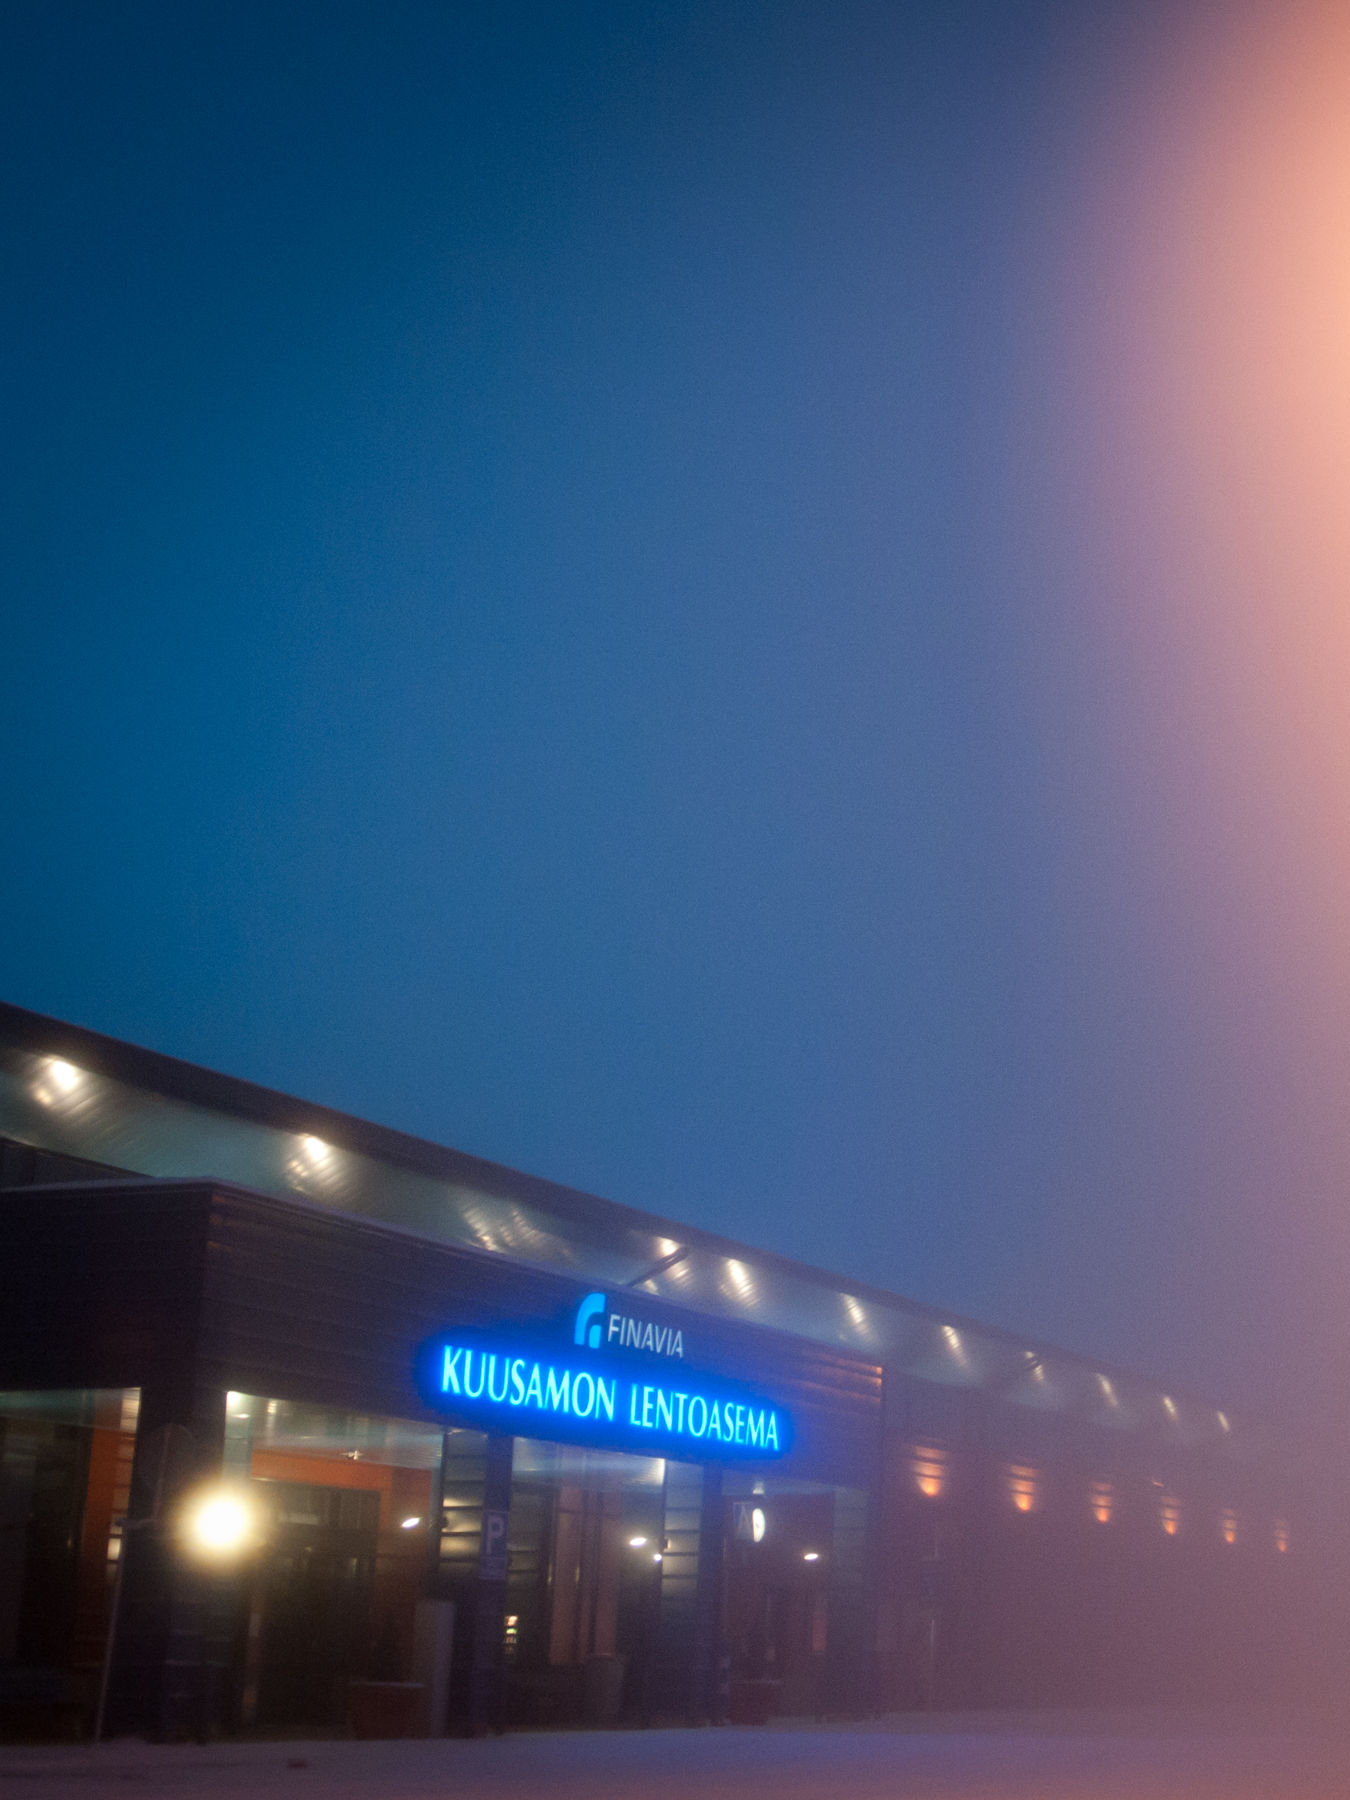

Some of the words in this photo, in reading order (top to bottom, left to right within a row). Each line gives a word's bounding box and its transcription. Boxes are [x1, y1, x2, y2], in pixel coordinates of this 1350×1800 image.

[608, 1314, 683, 1358] FINAVIA
[442, 1345, 616, 1421] KUUSAMON
[630, 1383, 780, 1451] LENTOASEMA
[486, 1515, 504, 1555] P
